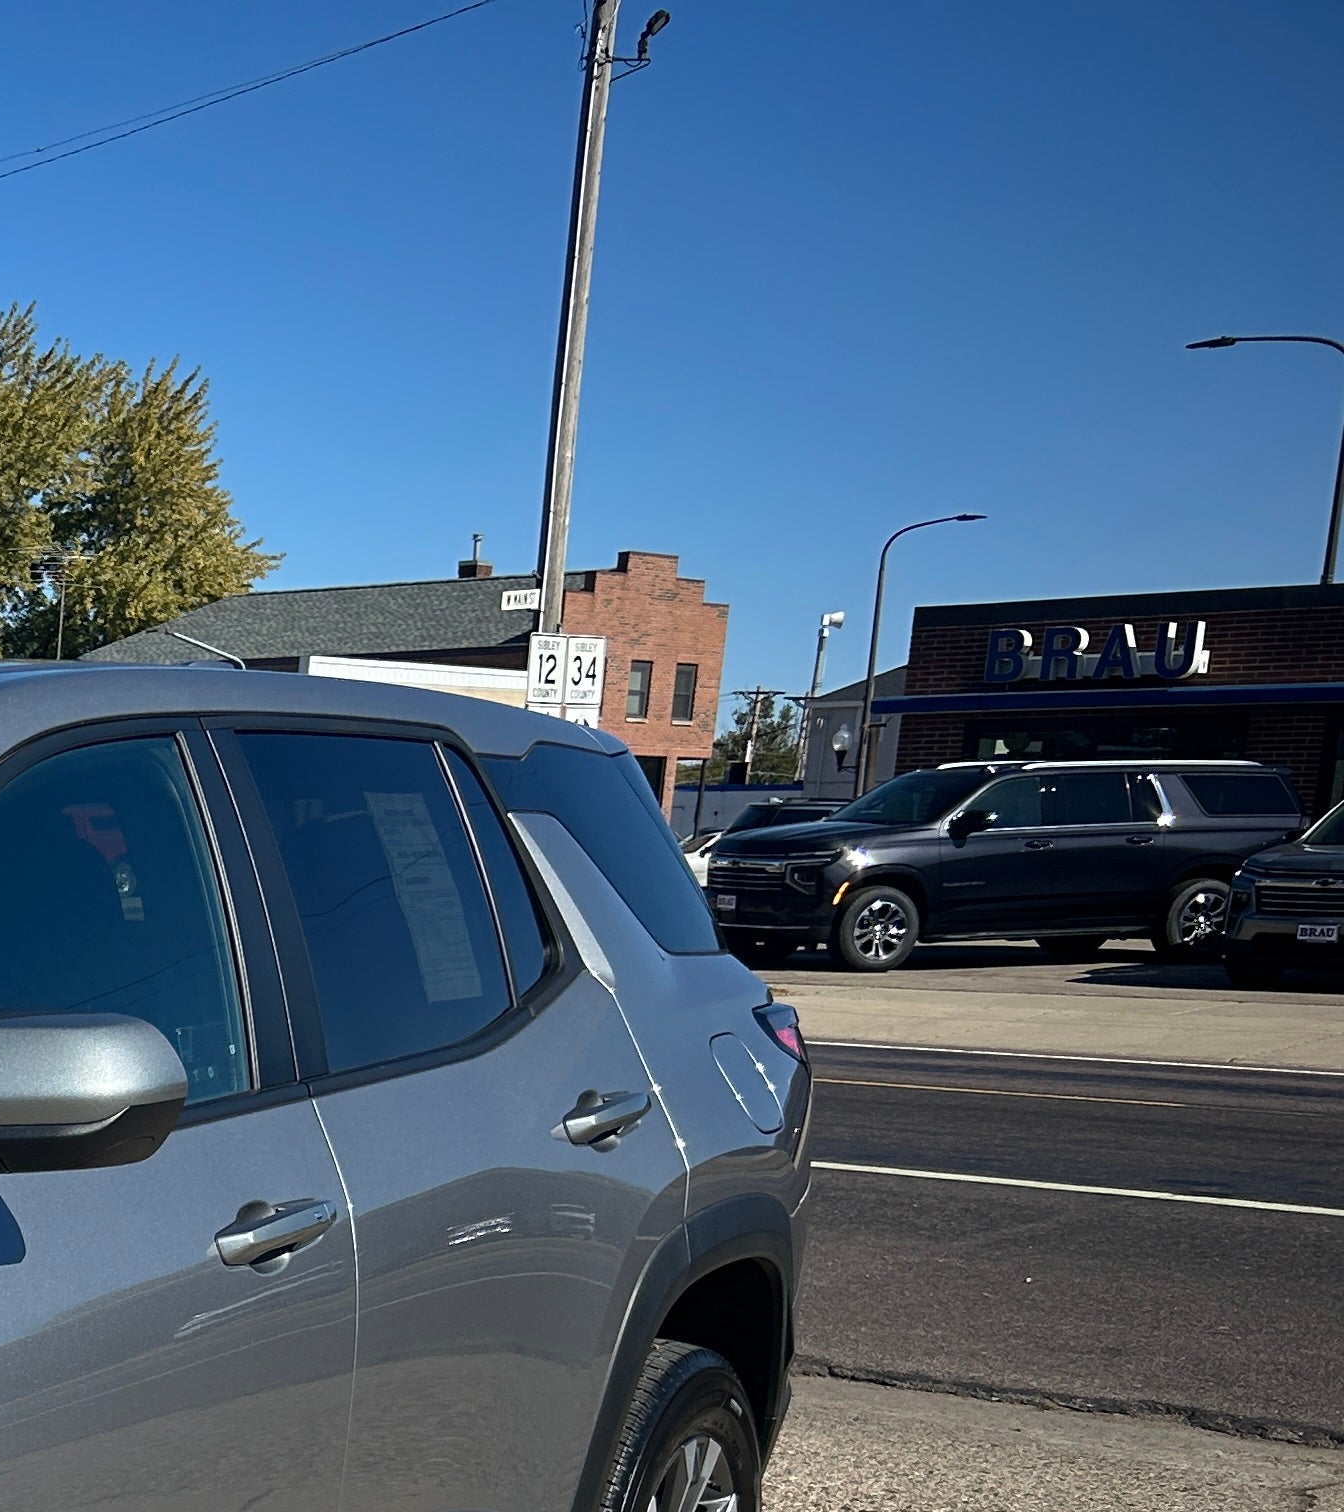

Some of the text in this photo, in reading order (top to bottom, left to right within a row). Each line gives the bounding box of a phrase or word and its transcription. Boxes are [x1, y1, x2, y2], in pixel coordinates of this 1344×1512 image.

[513, 592, 528, 606] MAIN
[537, 639, 561, 651] SIBLEY
[574, 642, 598, 653] SIBLEY
[984, 621, 1207, 683] BRAU
[538, 653, 558, 685] 12
[571, 655, 597, 687] 34
[532, 687, 559, 698] COUNTY
[570, 689, 596, 700] COUNTY
[1298, 927, 1335, 938] BRAU
